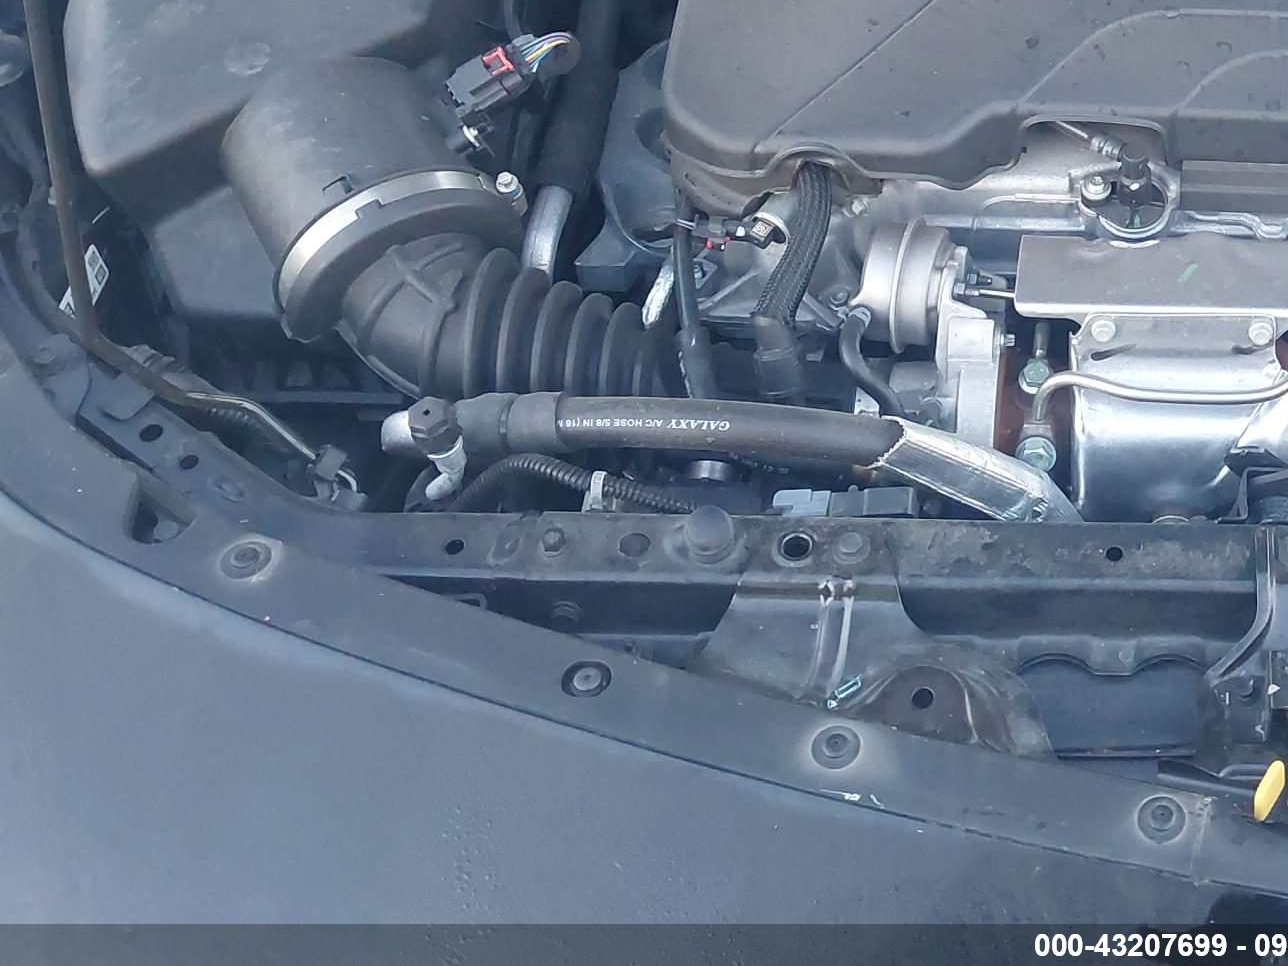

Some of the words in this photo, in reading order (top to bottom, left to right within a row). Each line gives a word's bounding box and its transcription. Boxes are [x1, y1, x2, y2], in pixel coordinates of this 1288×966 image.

[583, 417, 594, 427] IN
[596, 417, 611, 427] 5/8
[614, 418, 643, 427] HOSE
[645, 419, 663, 428] A/C
[667, 418, 730, 431] GALAXY
